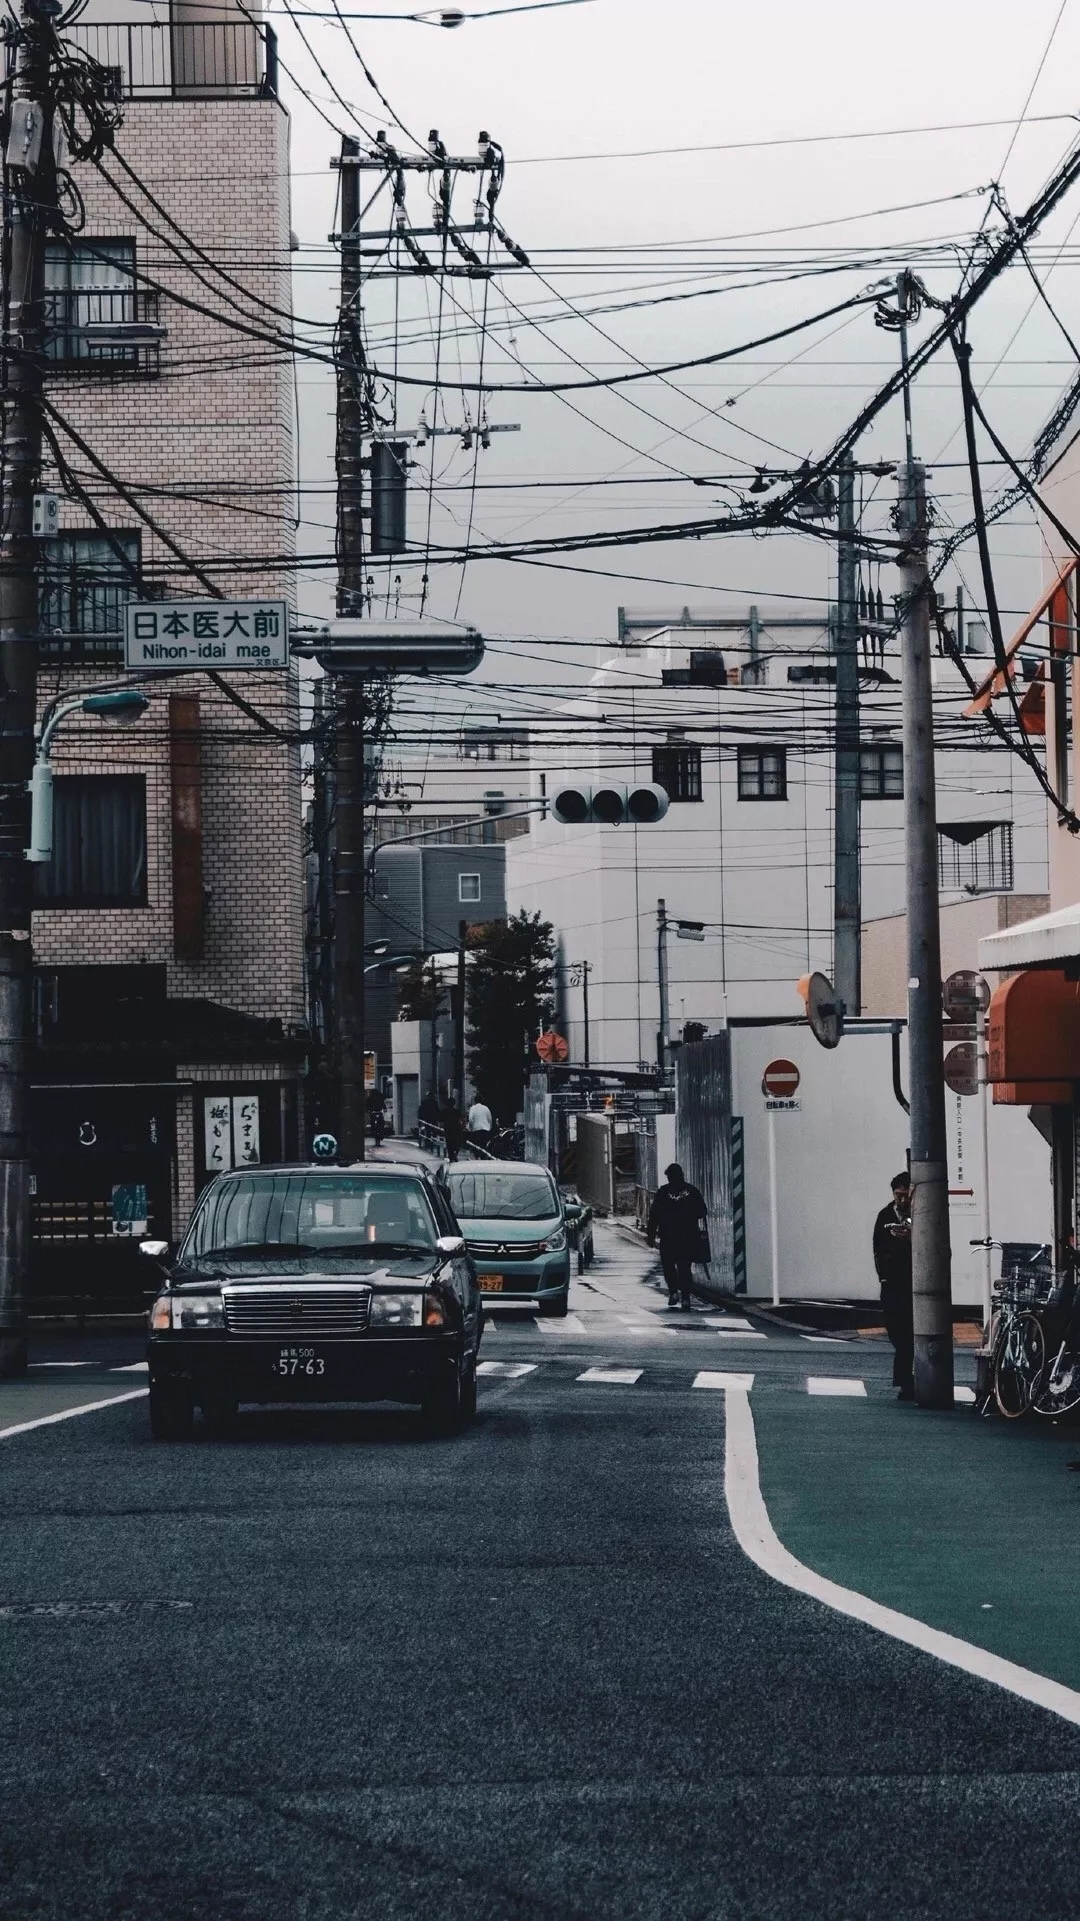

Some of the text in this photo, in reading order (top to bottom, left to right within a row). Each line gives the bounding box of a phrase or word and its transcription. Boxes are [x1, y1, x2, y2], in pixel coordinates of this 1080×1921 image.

[134, 609, 280, 639] 日本医大前
[143, 643, 271, 659] Nihon-idai mae
[319, 1141, 329, 1151] N
[299, 1348, 315, 1357] 500
[279, 1359, 325, 1375] 57-63
